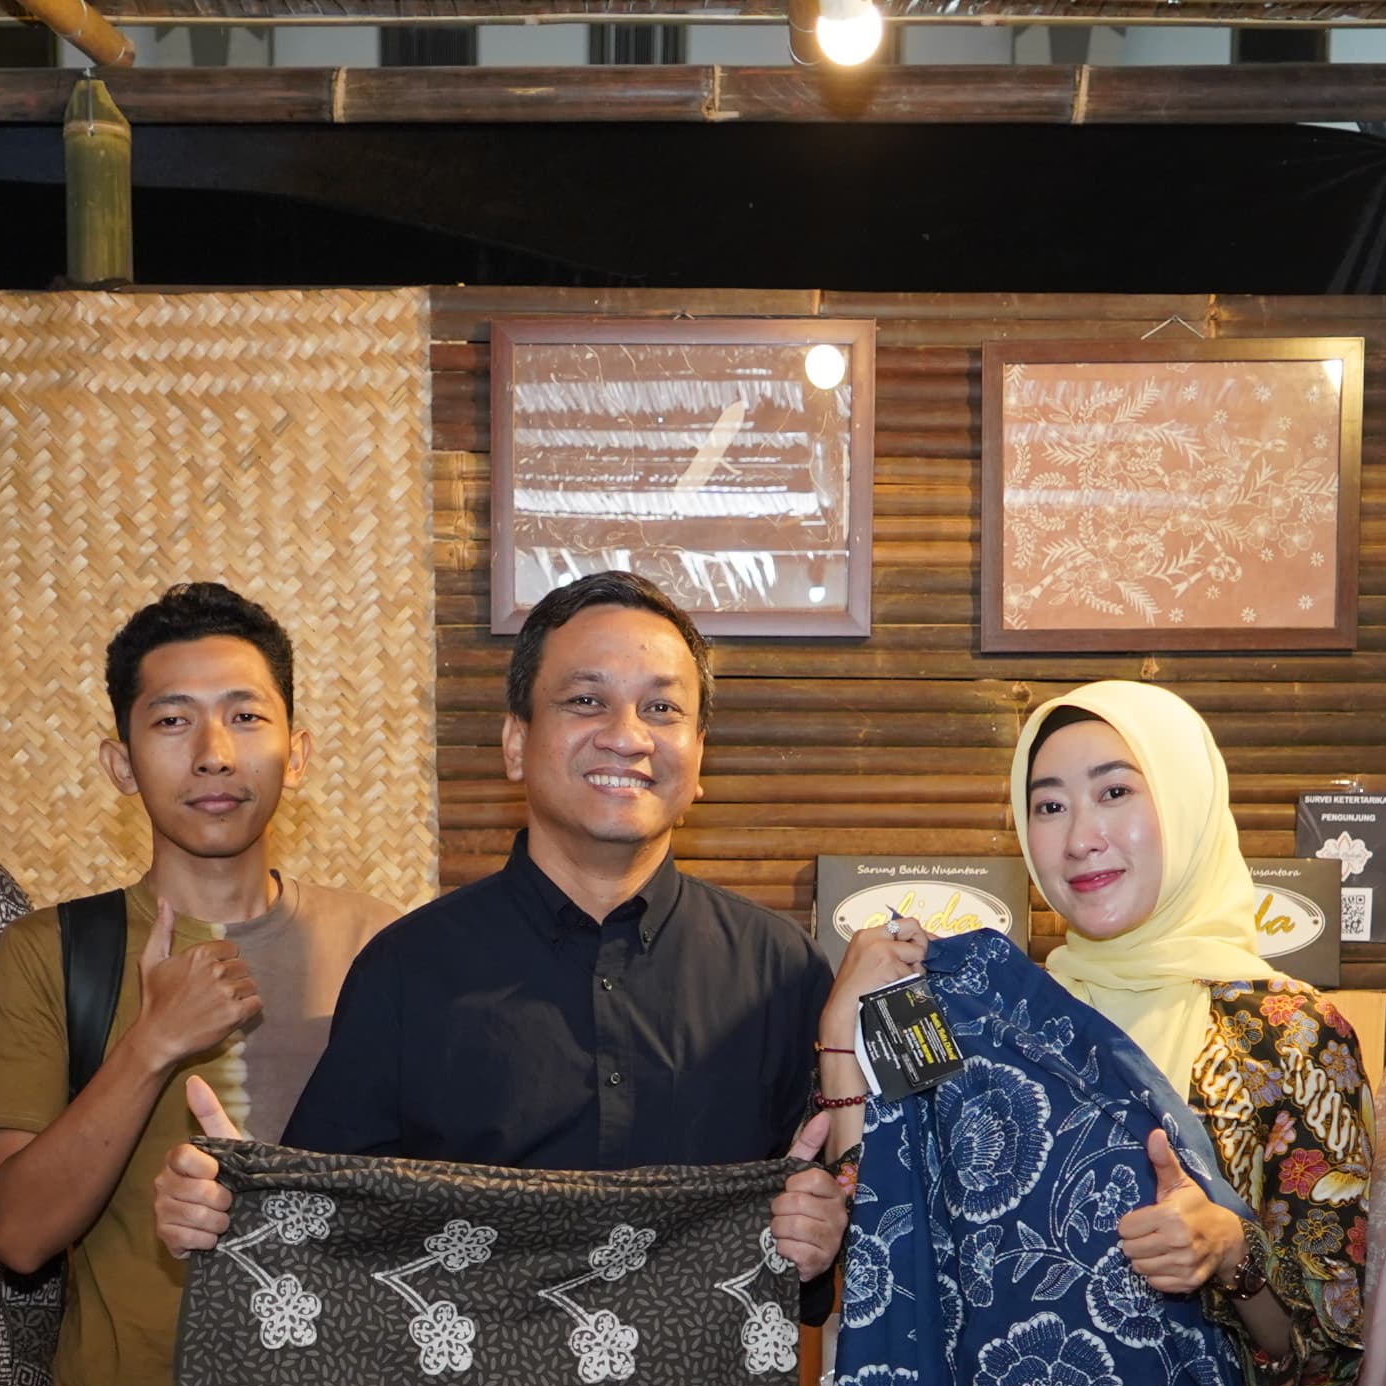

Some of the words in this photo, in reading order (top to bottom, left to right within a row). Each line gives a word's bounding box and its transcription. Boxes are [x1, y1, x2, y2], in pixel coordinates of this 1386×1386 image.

[1304, 795, 1332, 804] SURVEI
[1321, 813, 1376, 822] PENGUNJUNG
[856, 864, 896, 876] Sarung
[898, 864, 930, 875] Batik
[931, 864, 989, 876] Nusantara
